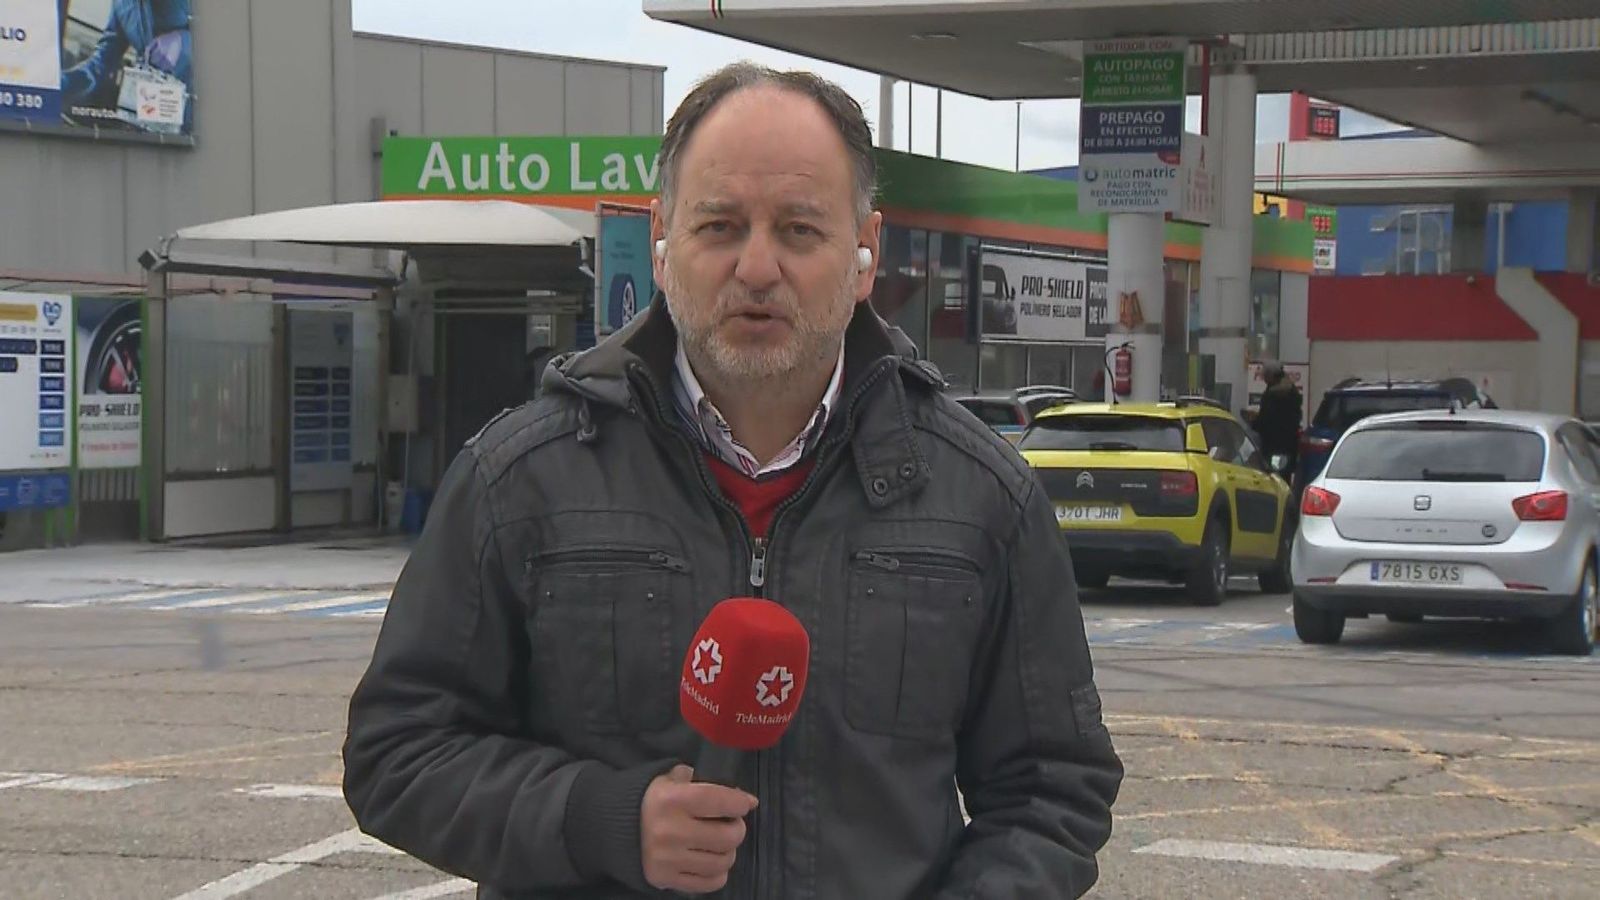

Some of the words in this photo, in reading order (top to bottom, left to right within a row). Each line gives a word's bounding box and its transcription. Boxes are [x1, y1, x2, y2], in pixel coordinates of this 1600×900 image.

[1093, 58, 1175, 72] AUTOPAGO
[16, 93, 43, 109] 380
[1099, 110, 1165, 124] PREPAGO
[1101, 126, 1115, 136] EN
[1117, 125, 1162, 135] EFECTIVO
[1084, 138, 1095, 147] DE
[1148, 136, 1179, 145] HORAS
[418, 142, 550, 191] Auto
[1102, 166, 1176, 179] automatric
[1107, 181, 1130, 190] PAGO
[1132, 180, 1151, 189] CON
[1090, 189, 1168, 198] RECONOCIMIENTO
[1021, 275, 1084, 300] PRO-SHIELD
[1382, 563, 1422, 580] 7815
[1428, 566, 1460, 581] GXS
[681, 676, 720, 716] TeleMadrid
[735, 711, 793, 726] TeleMadrid
